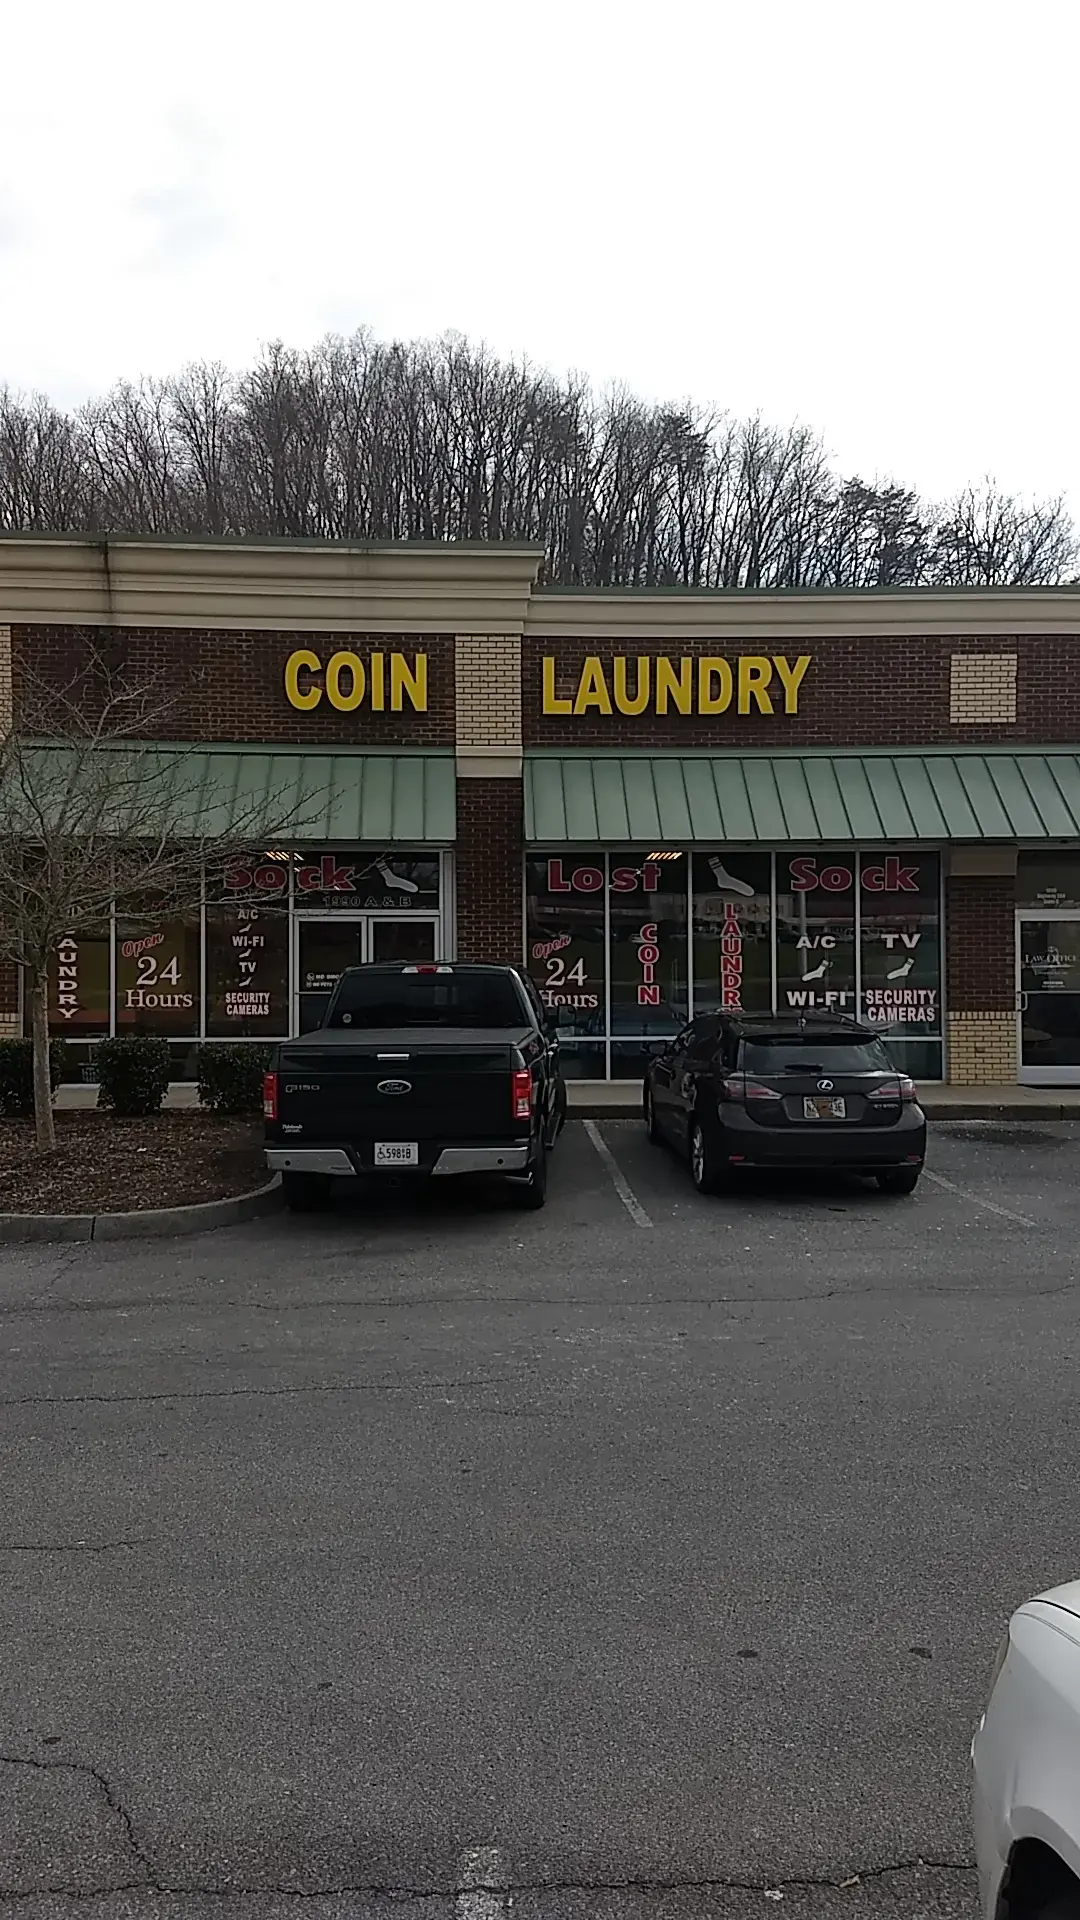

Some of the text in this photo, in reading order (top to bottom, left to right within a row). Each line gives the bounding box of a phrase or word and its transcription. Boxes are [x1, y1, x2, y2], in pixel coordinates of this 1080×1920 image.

[285, 649, 427, 713] COIN
[542, 655, 812, 716] LAUNDRY
[224, 855, 357, 891] Sock
[547, 858, 661, 892] Lost
[789, 856, 920, 891] Sock
[364, 895, 378, 907] A
[399, 896, 412, 907] B
[237, 908, 259, 920] A/C
[121, 932, 164, 957] Open
[232, 935, 265, 948] WI-FI
[532, 934, 571, 959] Open
[796, 935, 837, 949] A/C
[880, 933, 921, 949] TV
[136, 956, 182, 986] 24
[239, 961, 257, 974] TV
[545, 957, 588, 986] 24
[637, 923, 660, 1005] COIN
[57, 931, 80, 1019] AUNDRY
[124, 989, 193, 1008] Hours
[225, 992, 271, 1004] SECURITY
[538, 989, 599, 1009] Hours
[786, 991, 847, 1006] WI-FI
[866, 989, 936, 1004] SECURITY
[226, 1004, 270, 1016] CAMERAS
[868, 1007, 935, 1022] CAMERAS
